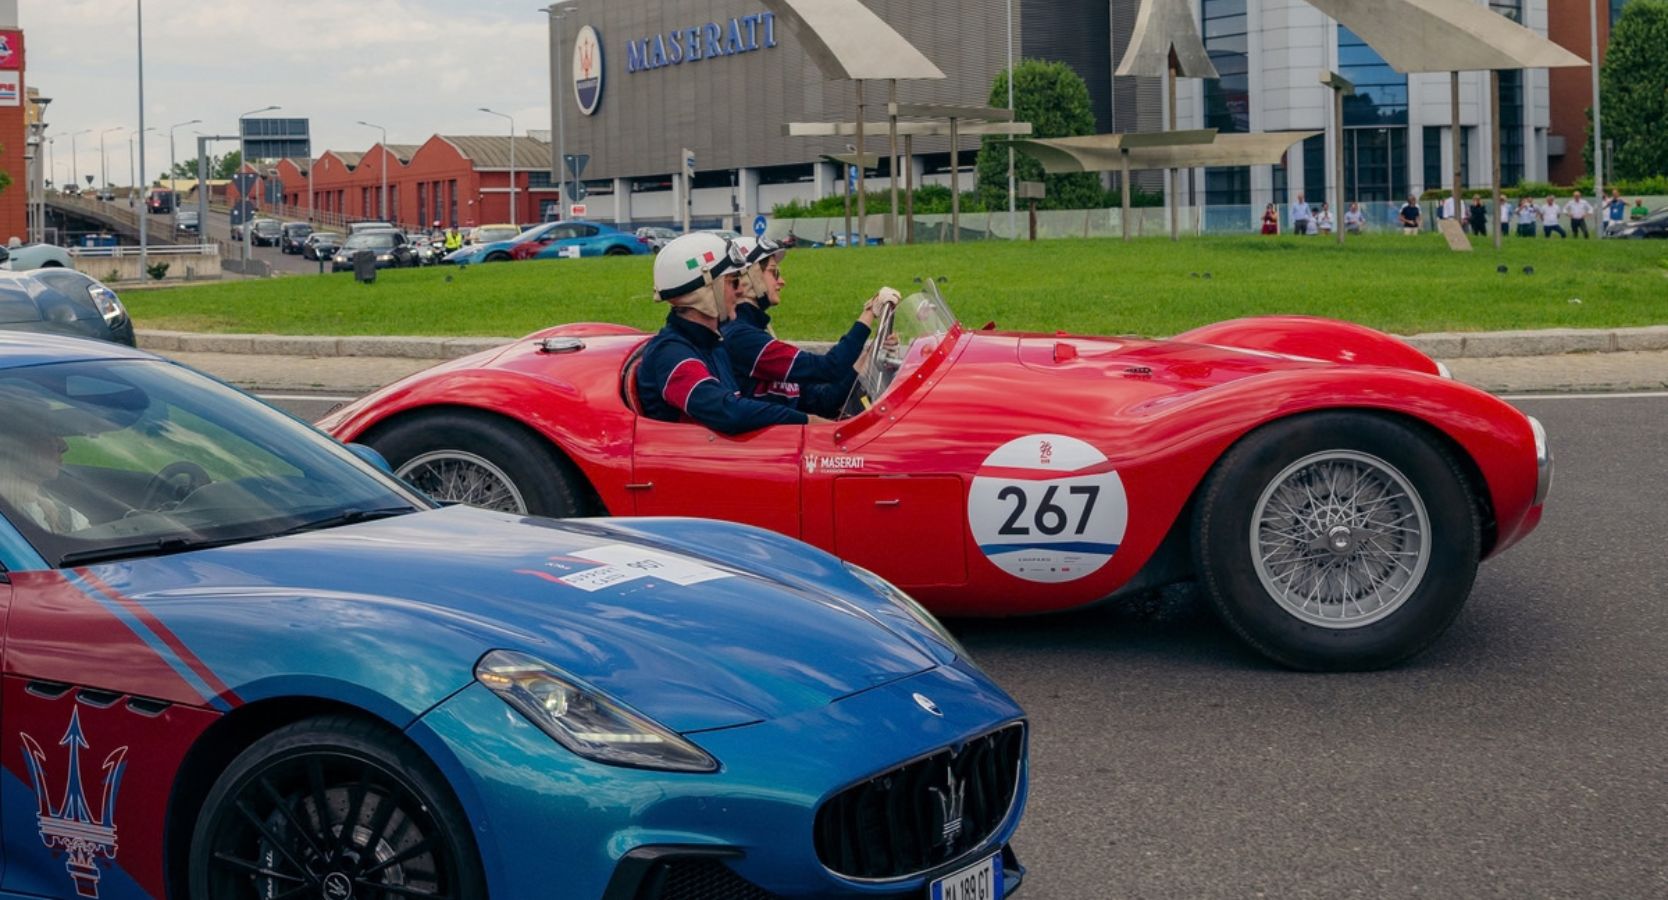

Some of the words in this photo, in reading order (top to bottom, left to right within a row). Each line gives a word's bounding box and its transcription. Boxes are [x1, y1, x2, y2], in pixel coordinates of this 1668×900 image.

[625, 10, 778, 73] MASERATI
[820, 456, 864, 469] MASERATI
[997, 485, 1100, 536] 267
[960, 875, 977, 900] 189
[978, 867, 989, 900] GT
